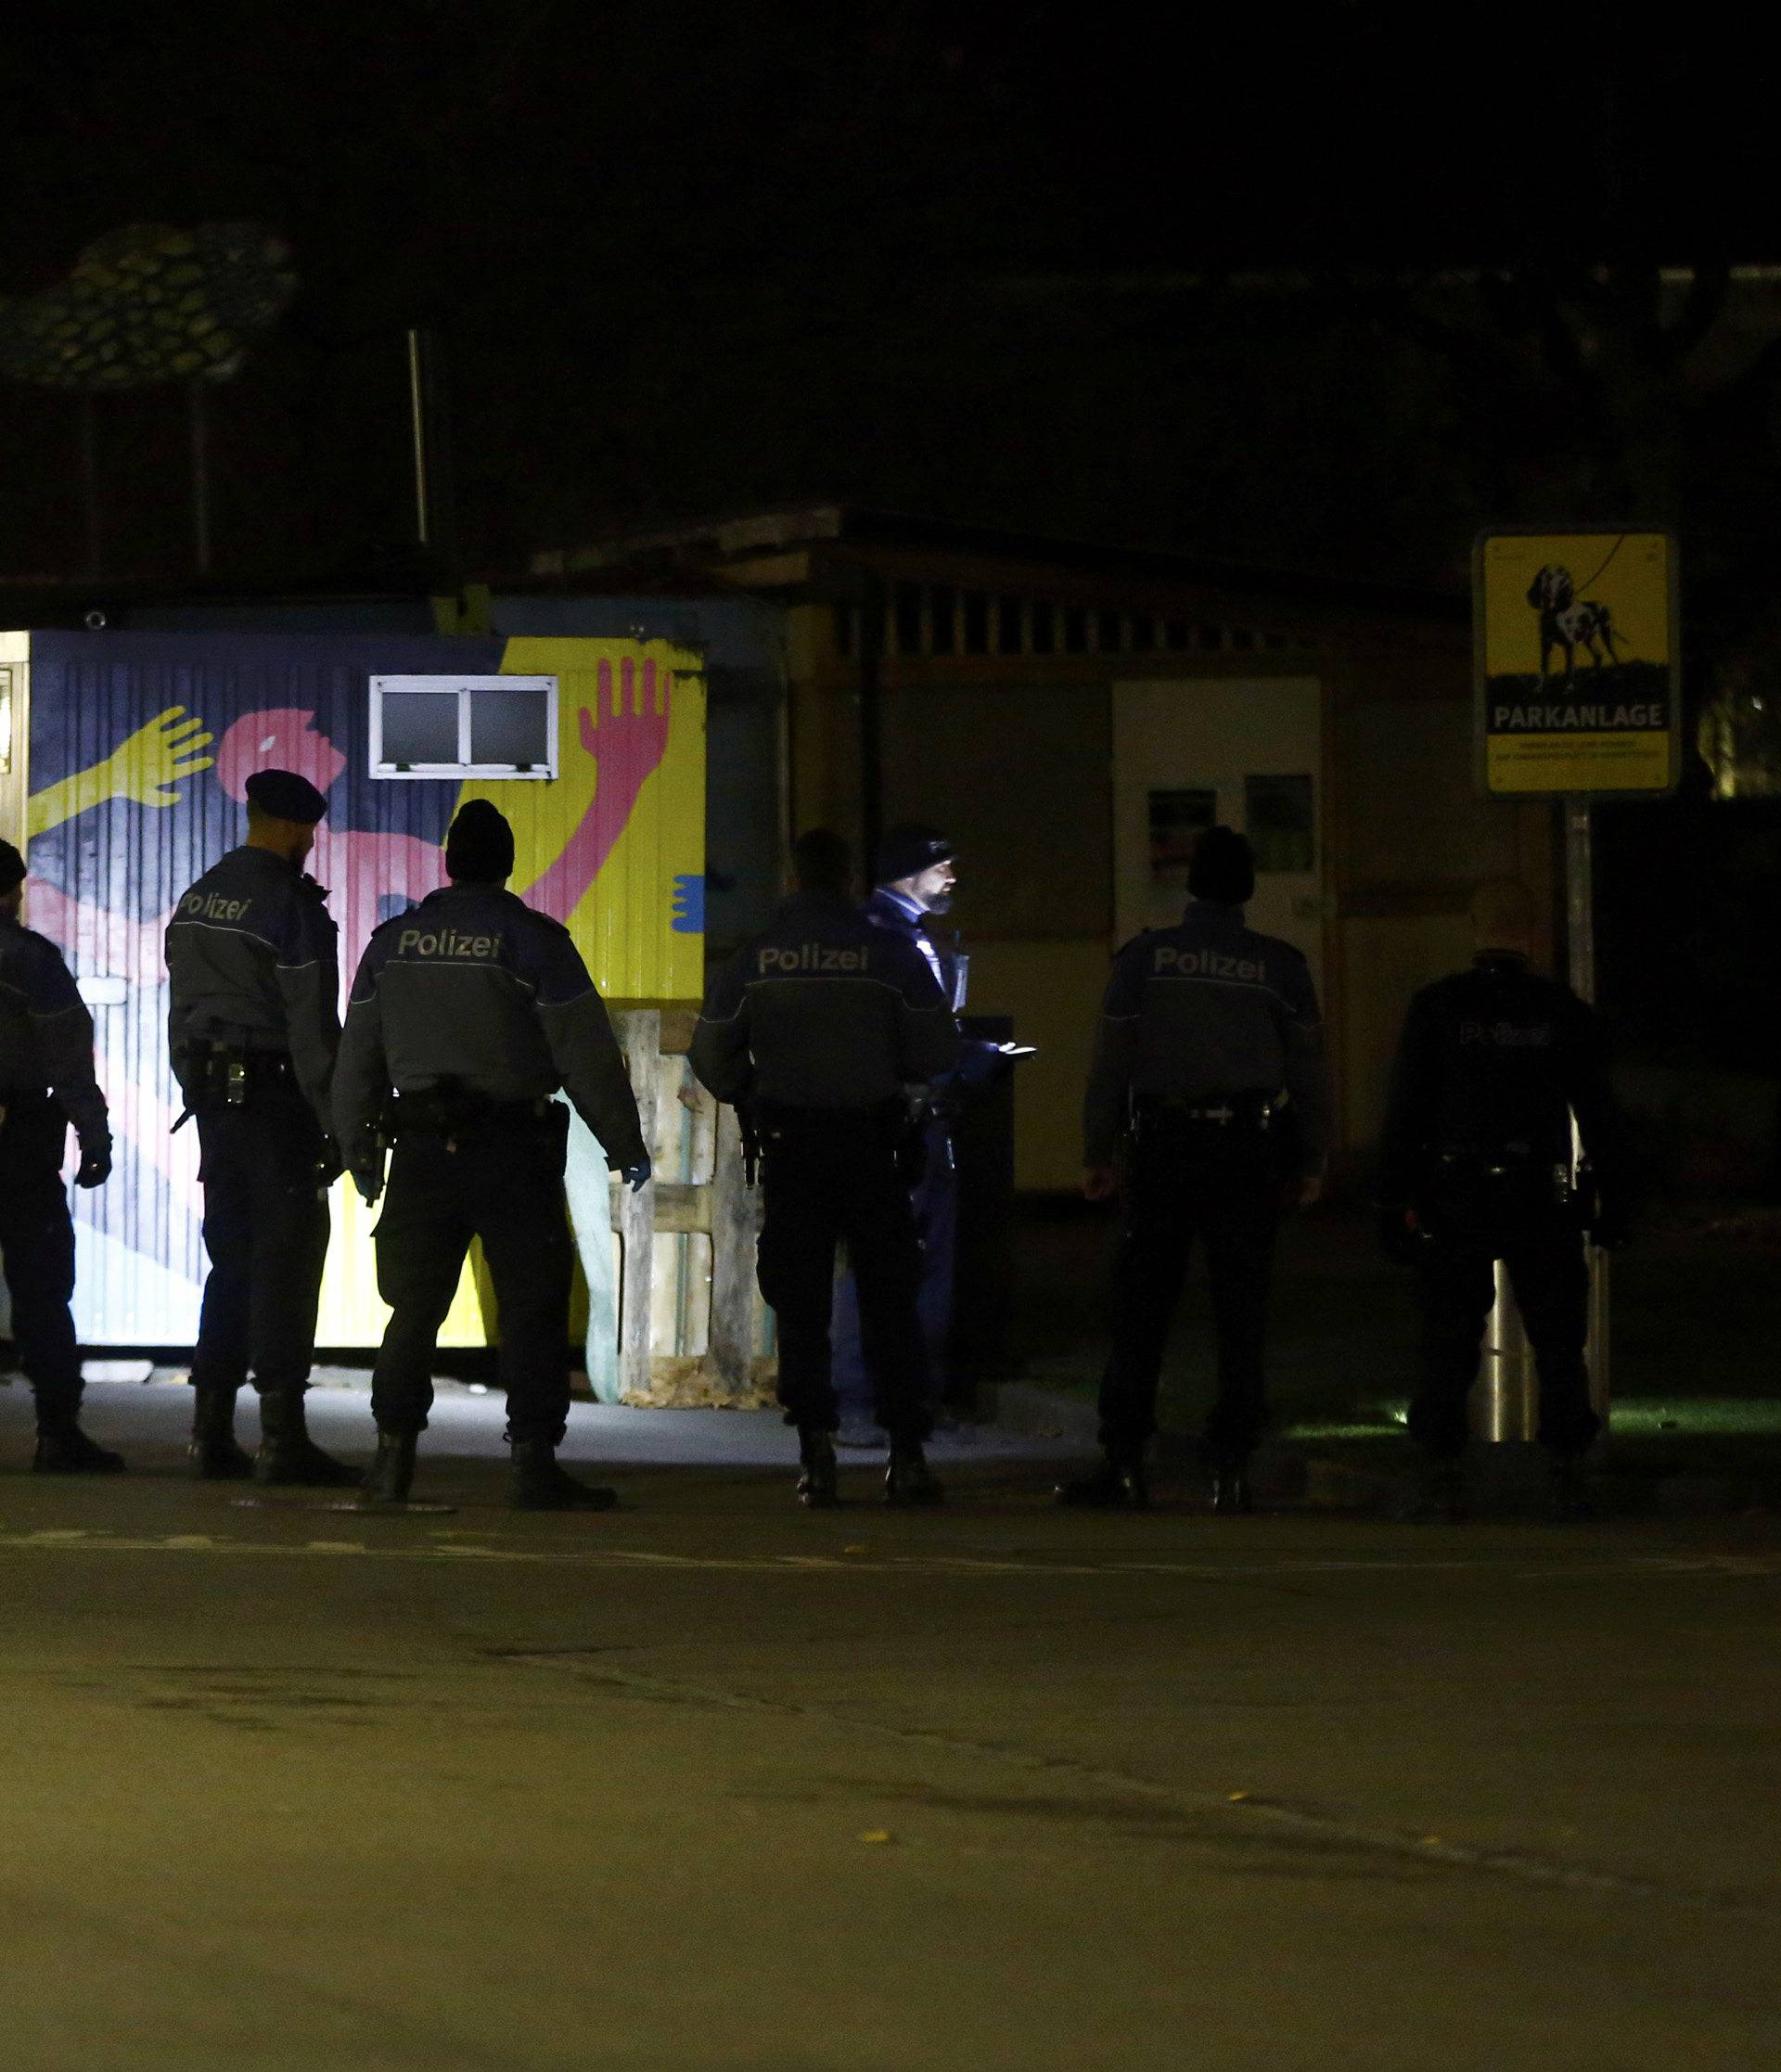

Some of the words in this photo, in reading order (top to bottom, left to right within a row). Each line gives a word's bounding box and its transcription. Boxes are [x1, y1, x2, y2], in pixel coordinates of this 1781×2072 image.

[1493, 703, 1662, 728] PARKANLAGE
[397, 929, 502, 958] Polizei
[758, 942, 870, 973] Polizei
[1154, 946, 1266, 981] Polizei
